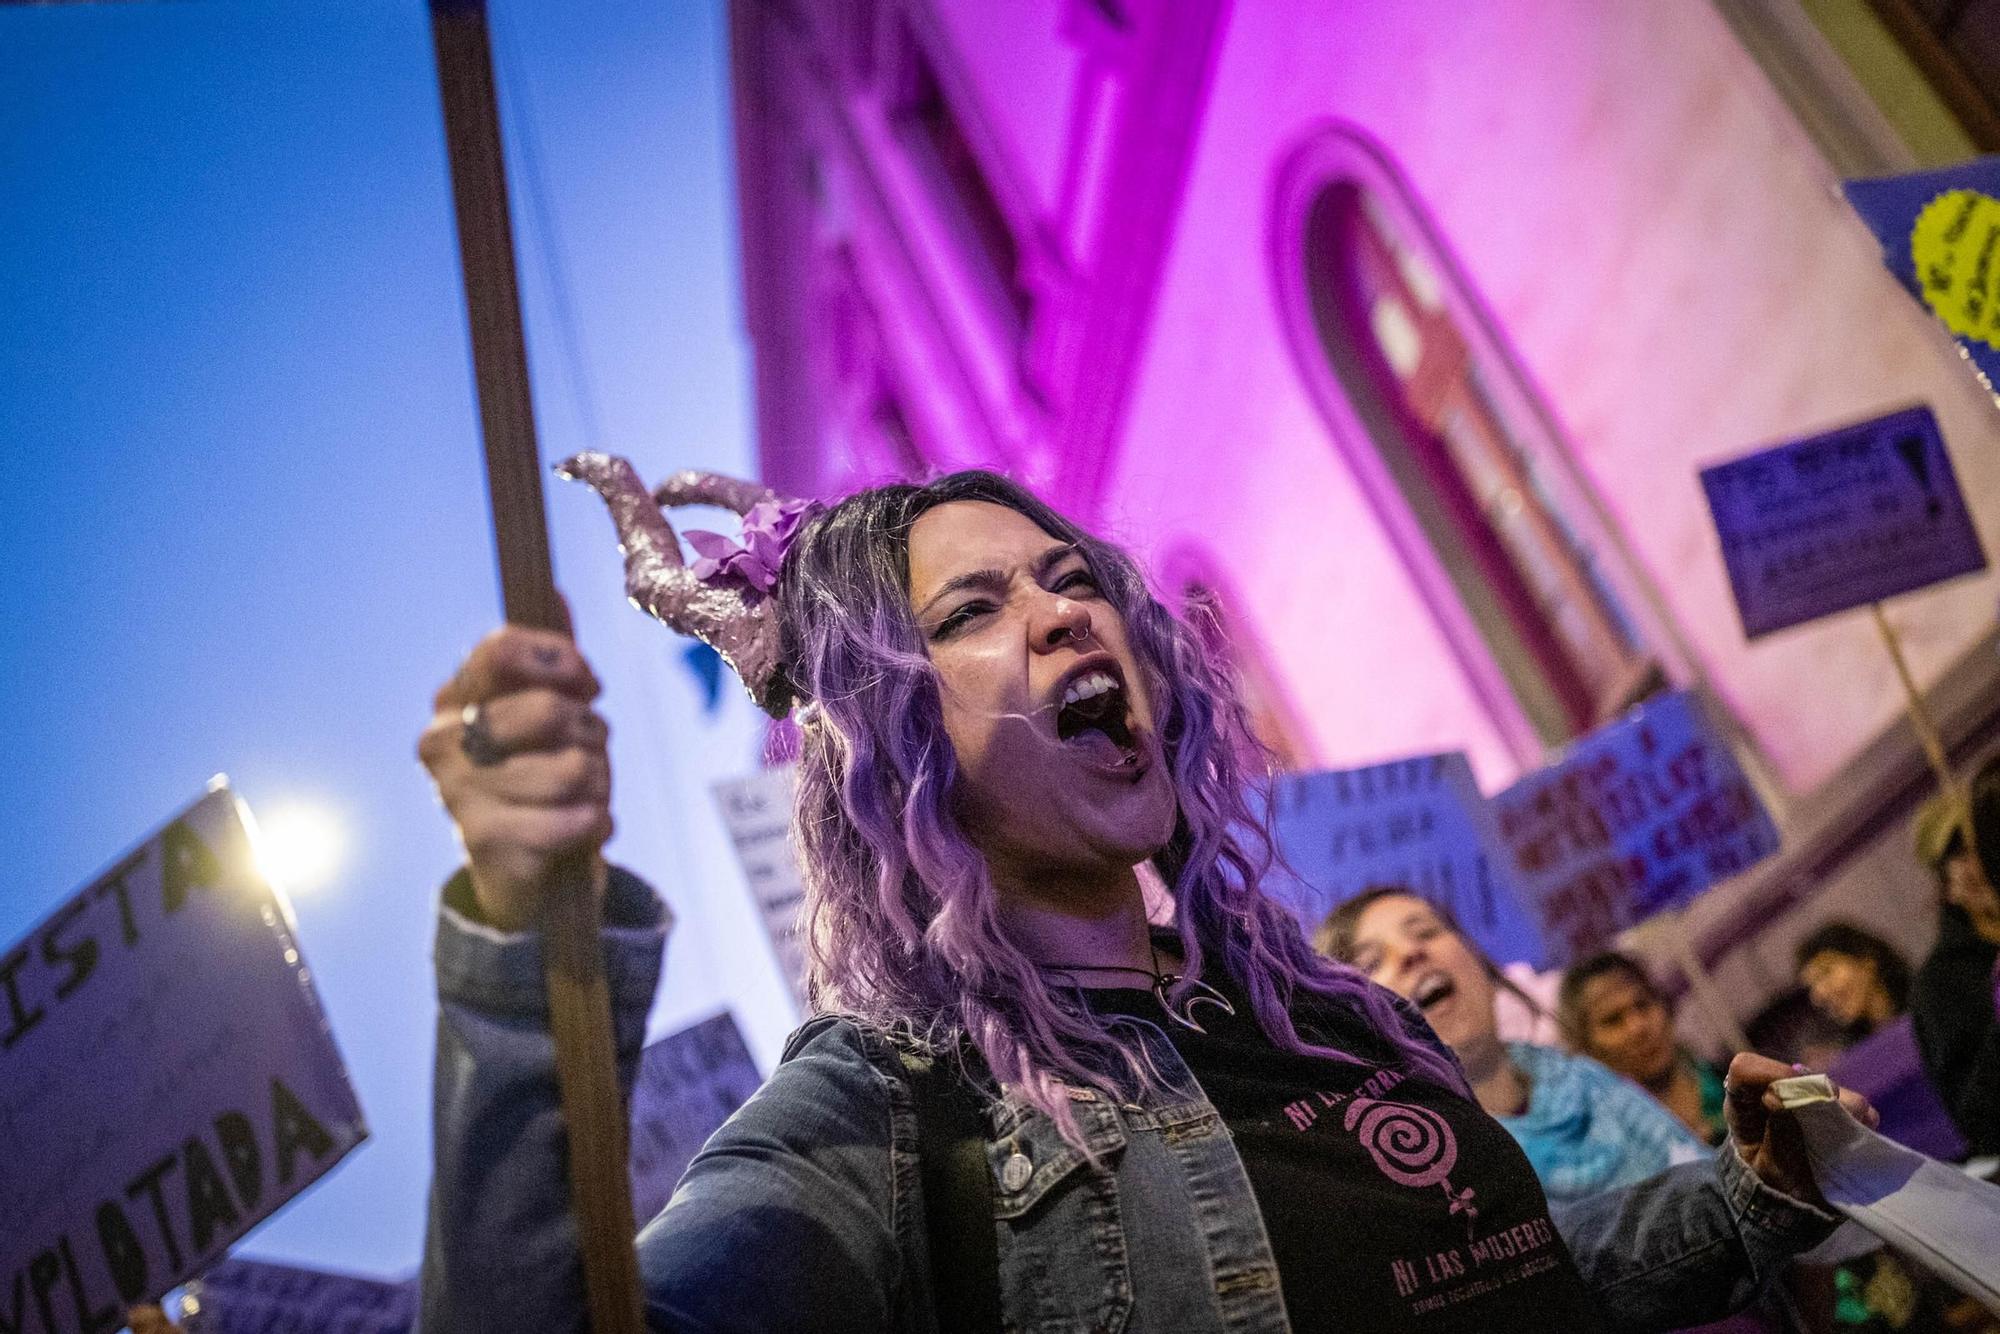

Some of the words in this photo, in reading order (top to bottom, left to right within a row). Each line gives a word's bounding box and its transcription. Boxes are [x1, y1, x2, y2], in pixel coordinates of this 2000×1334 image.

[1283, 1099, 1318, 1132] NI
[1391, 1258, 1419, 1298] NI
[1425, 1249, 1465, 1285] LAS
[1468, 1217, 1553, 1268] MUJERES
